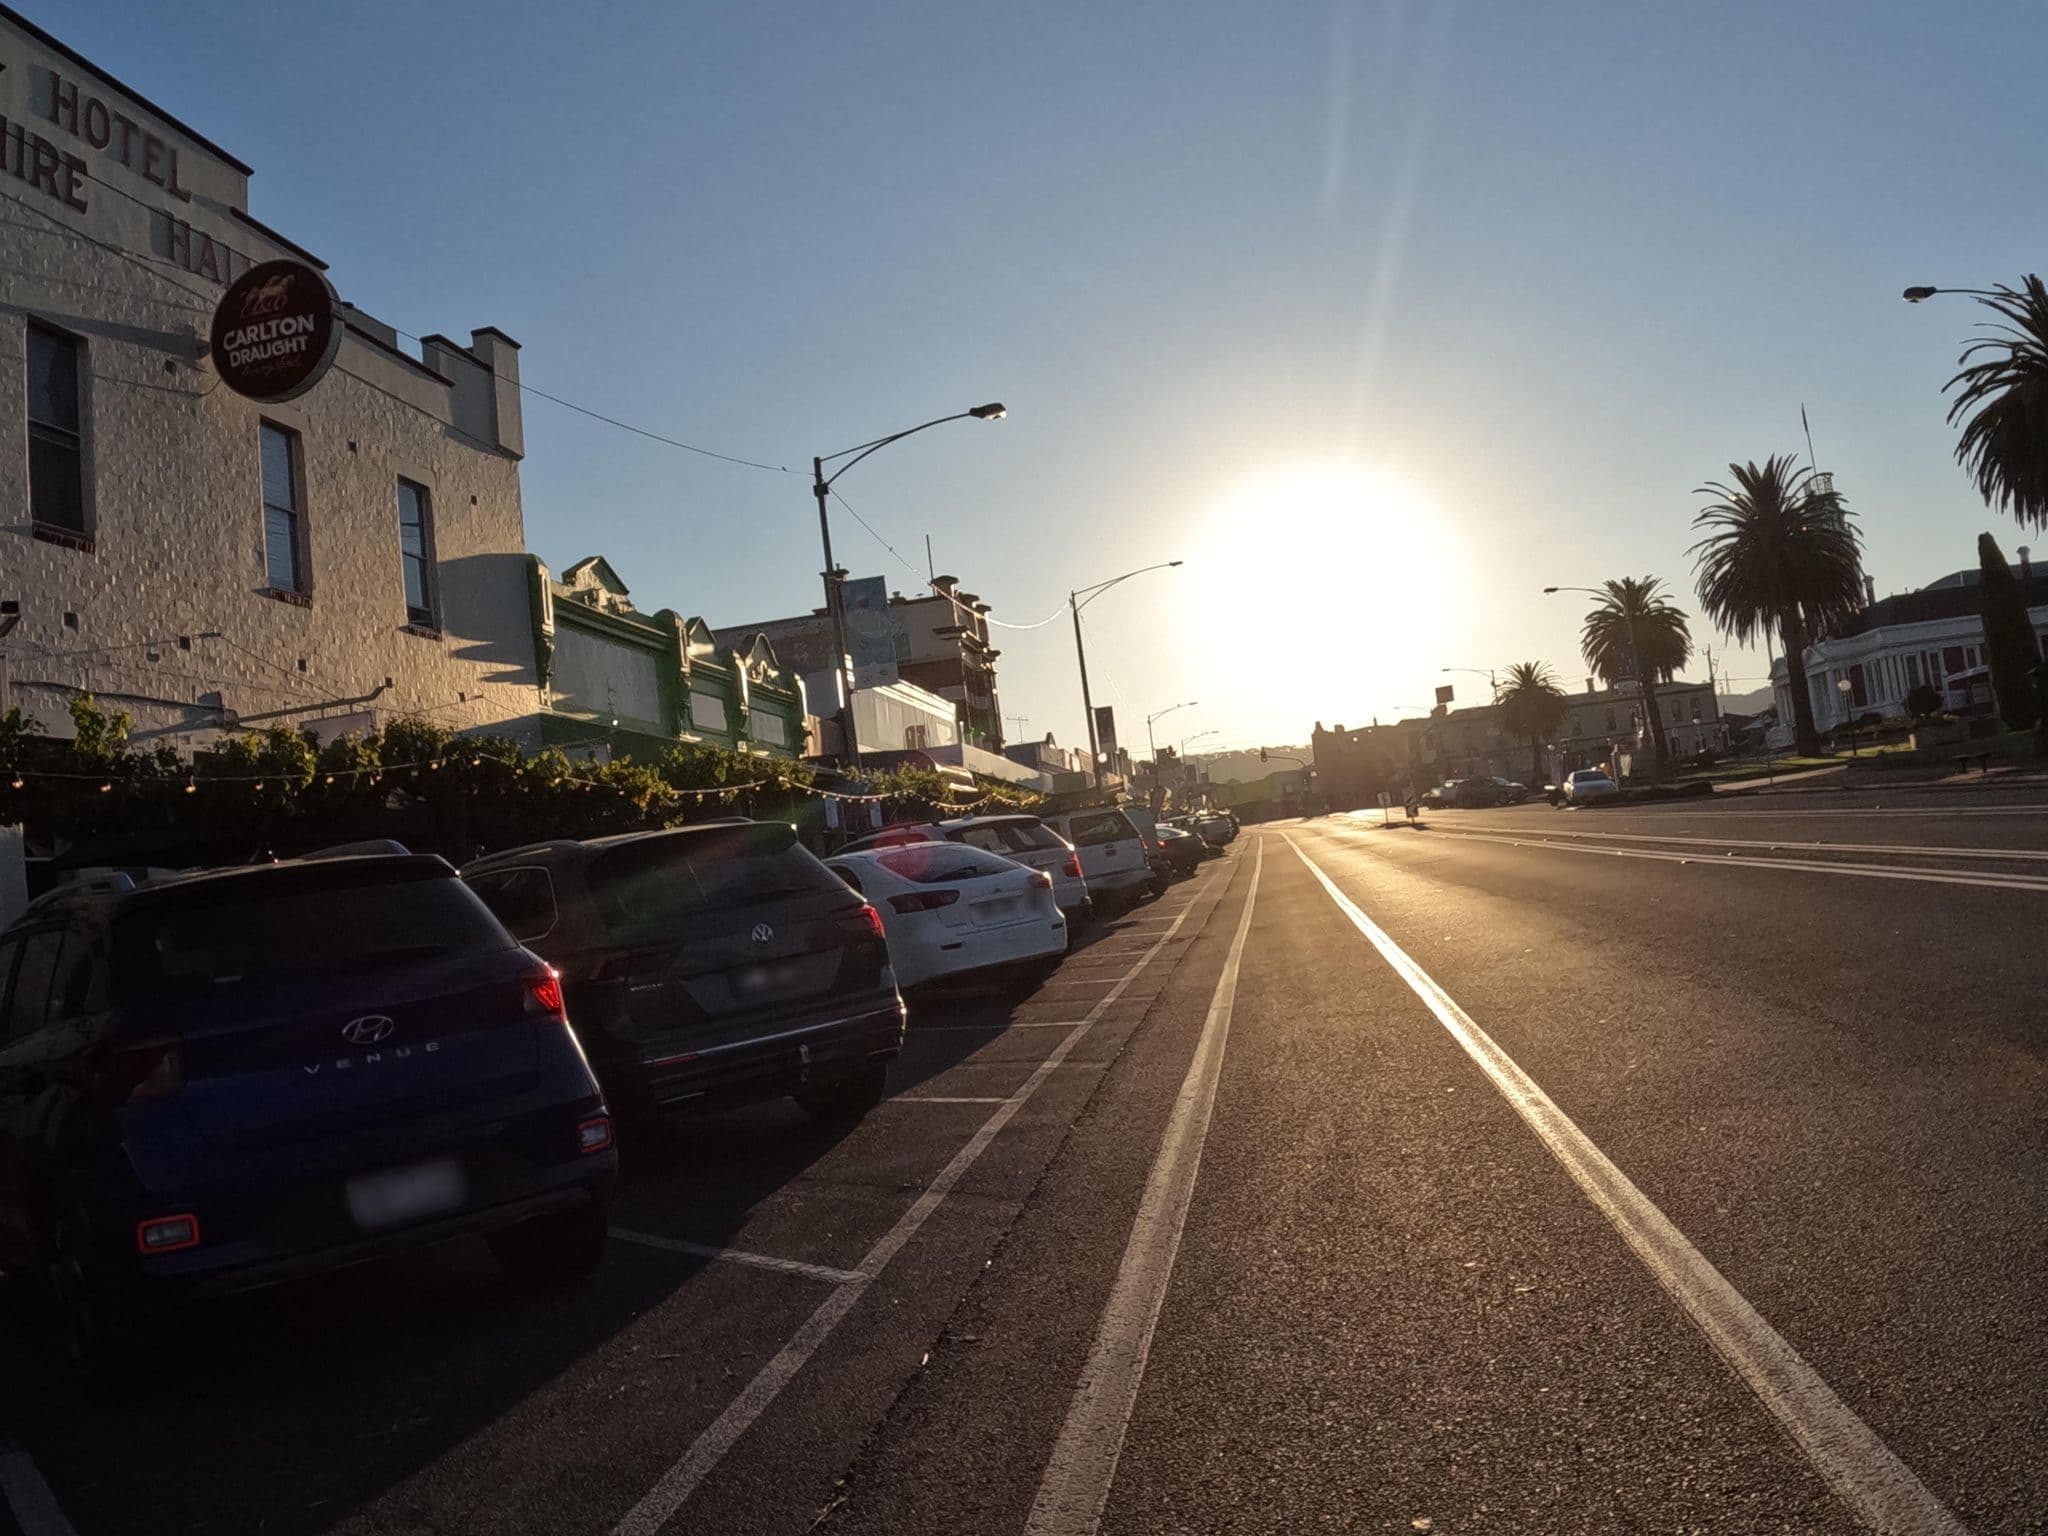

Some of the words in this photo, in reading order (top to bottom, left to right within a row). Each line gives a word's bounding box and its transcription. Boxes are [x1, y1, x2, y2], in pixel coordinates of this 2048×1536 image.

[50, 72, 191, 203] HOTEL
[223, 314, 315, 351] CARLTON
[229, 336, 309, 368] DRAUGHT
[304, 1042, 440, 1074] VENUE
